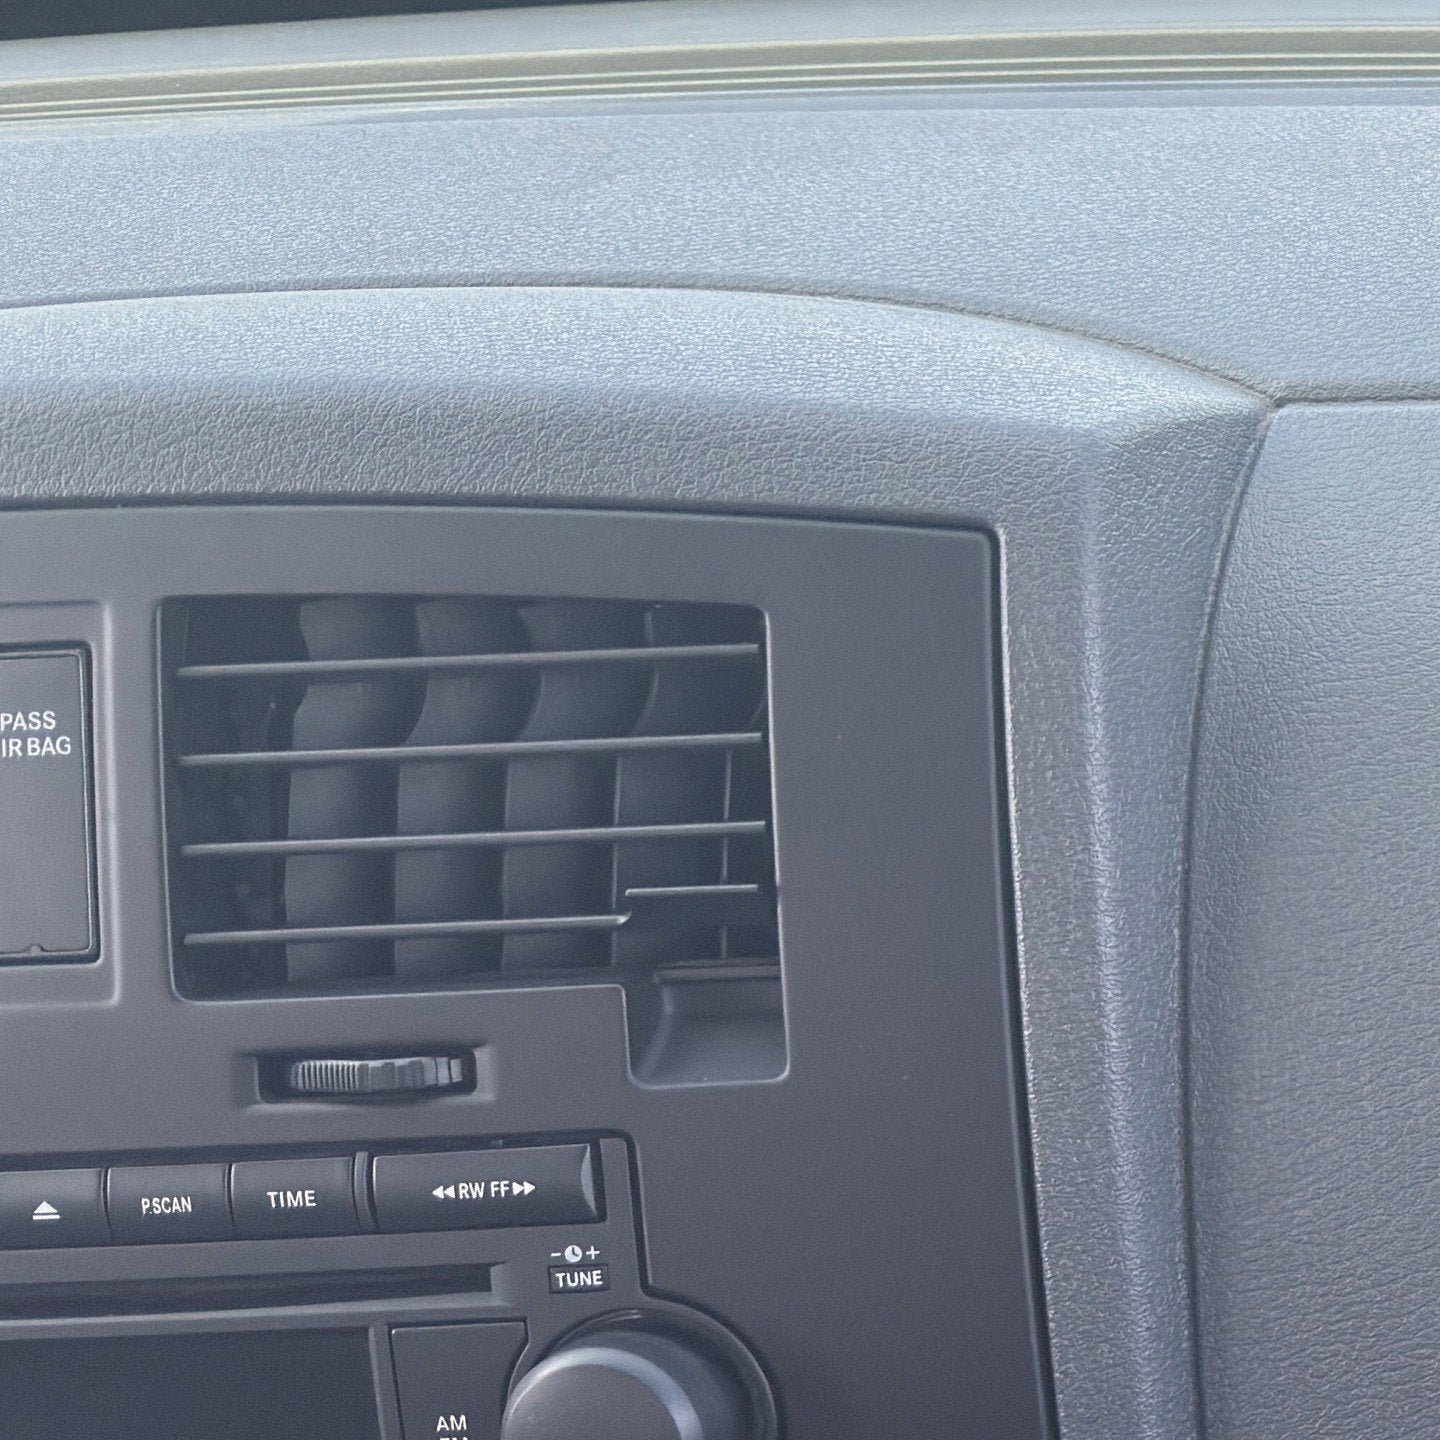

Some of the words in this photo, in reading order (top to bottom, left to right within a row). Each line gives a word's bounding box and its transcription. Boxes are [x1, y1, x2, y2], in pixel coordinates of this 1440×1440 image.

[0, 710, 56, 731] PASS
[28, 736, 72, 757] BAG
[267, 1188, 316, 1210] TIME
[458, 1181, 487, 1200] RW
[490, 1179, 510, 1198] FF
[555, 1269, 604, 1289] TUNE
[436, 1414, 468, 1432] AM
